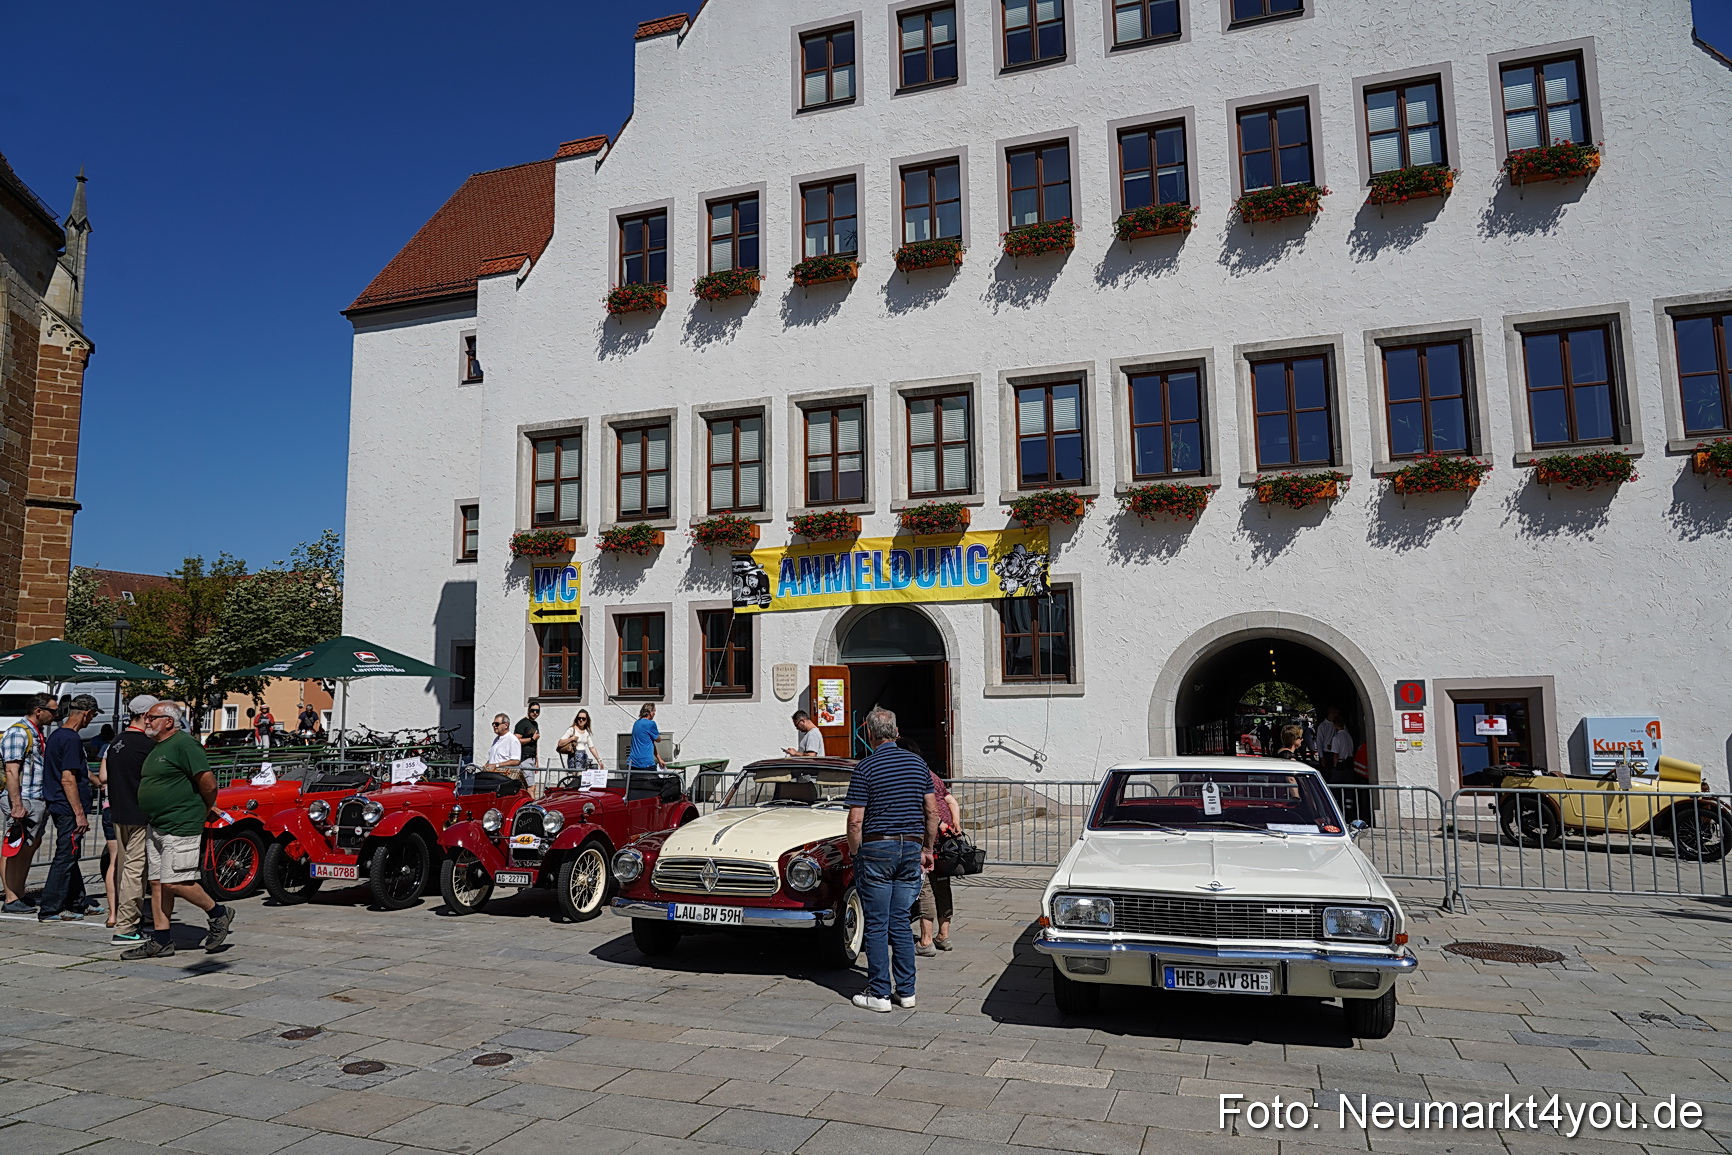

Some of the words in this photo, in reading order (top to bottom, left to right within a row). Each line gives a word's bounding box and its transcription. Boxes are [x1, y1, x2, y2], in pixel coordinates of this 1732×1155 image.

[777, 543, 990, 599] ANMELDUNG
[532, 566, 579, 604] WC
[1592, 738, 1645, 752] Kunst
[405, 761, 416, 769] 355
[316, 865, 328, 876] AA
[333, 866, 355, 878] 0788
[675, 905, 697, 920] LAU
[703, 907, 718, 922] BW
[719, 908, 742, 924] 59H
[1175, 969, 1206, 987] HEB
[1217, 972, 1237, 989] AV
[1240, 973, 1260, 990] 8H
